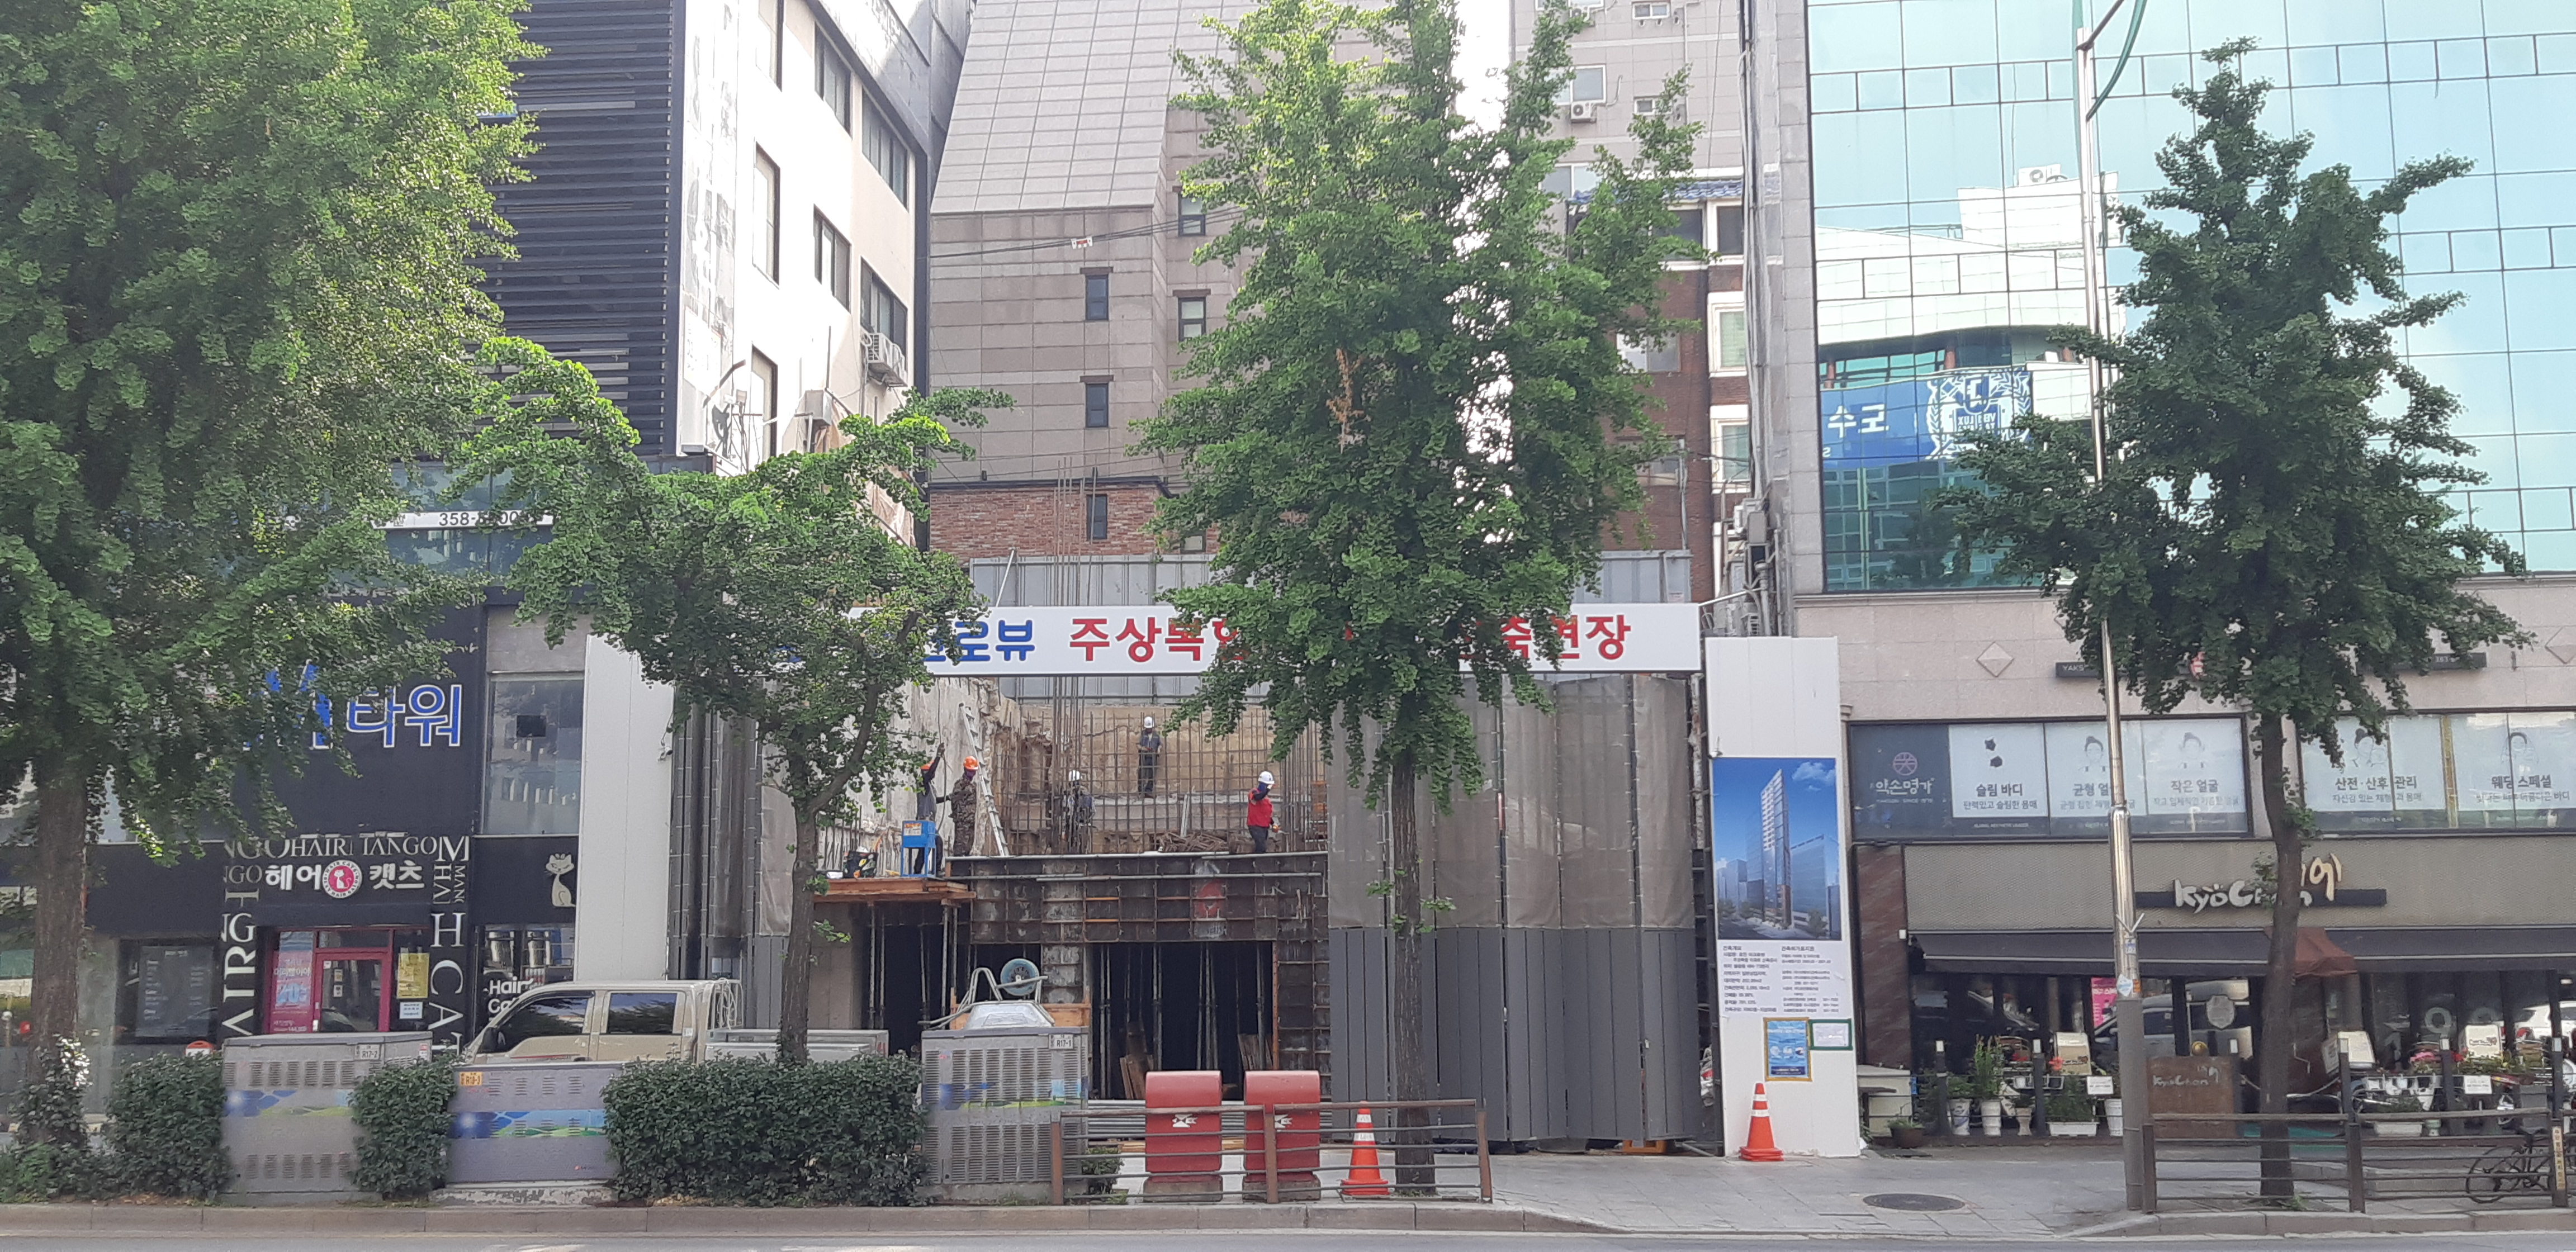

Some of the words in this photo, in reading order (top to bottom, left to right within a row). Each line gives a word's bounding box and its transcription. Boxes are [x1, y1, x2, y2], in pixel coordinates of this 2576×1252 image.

[1875, 777, 1932, 795] 약손명가
[2171, 780, 2194, 793] 작은
[2394, 775, 2418, 789] 관리
[2492, 776, 2513, 789] 웨딩
[2518, 775, 2551, 789] 스페셜
[1976, 784, 1997, 797] 슬림
[2001, 783, 2023, 796] 바디
[2073, 784, 2095, 796] 균형
[265, 865, 322, 890] 헤어
[369, 860, 425, 890] 캣츠
[489, 975, 534, 995] Hair
